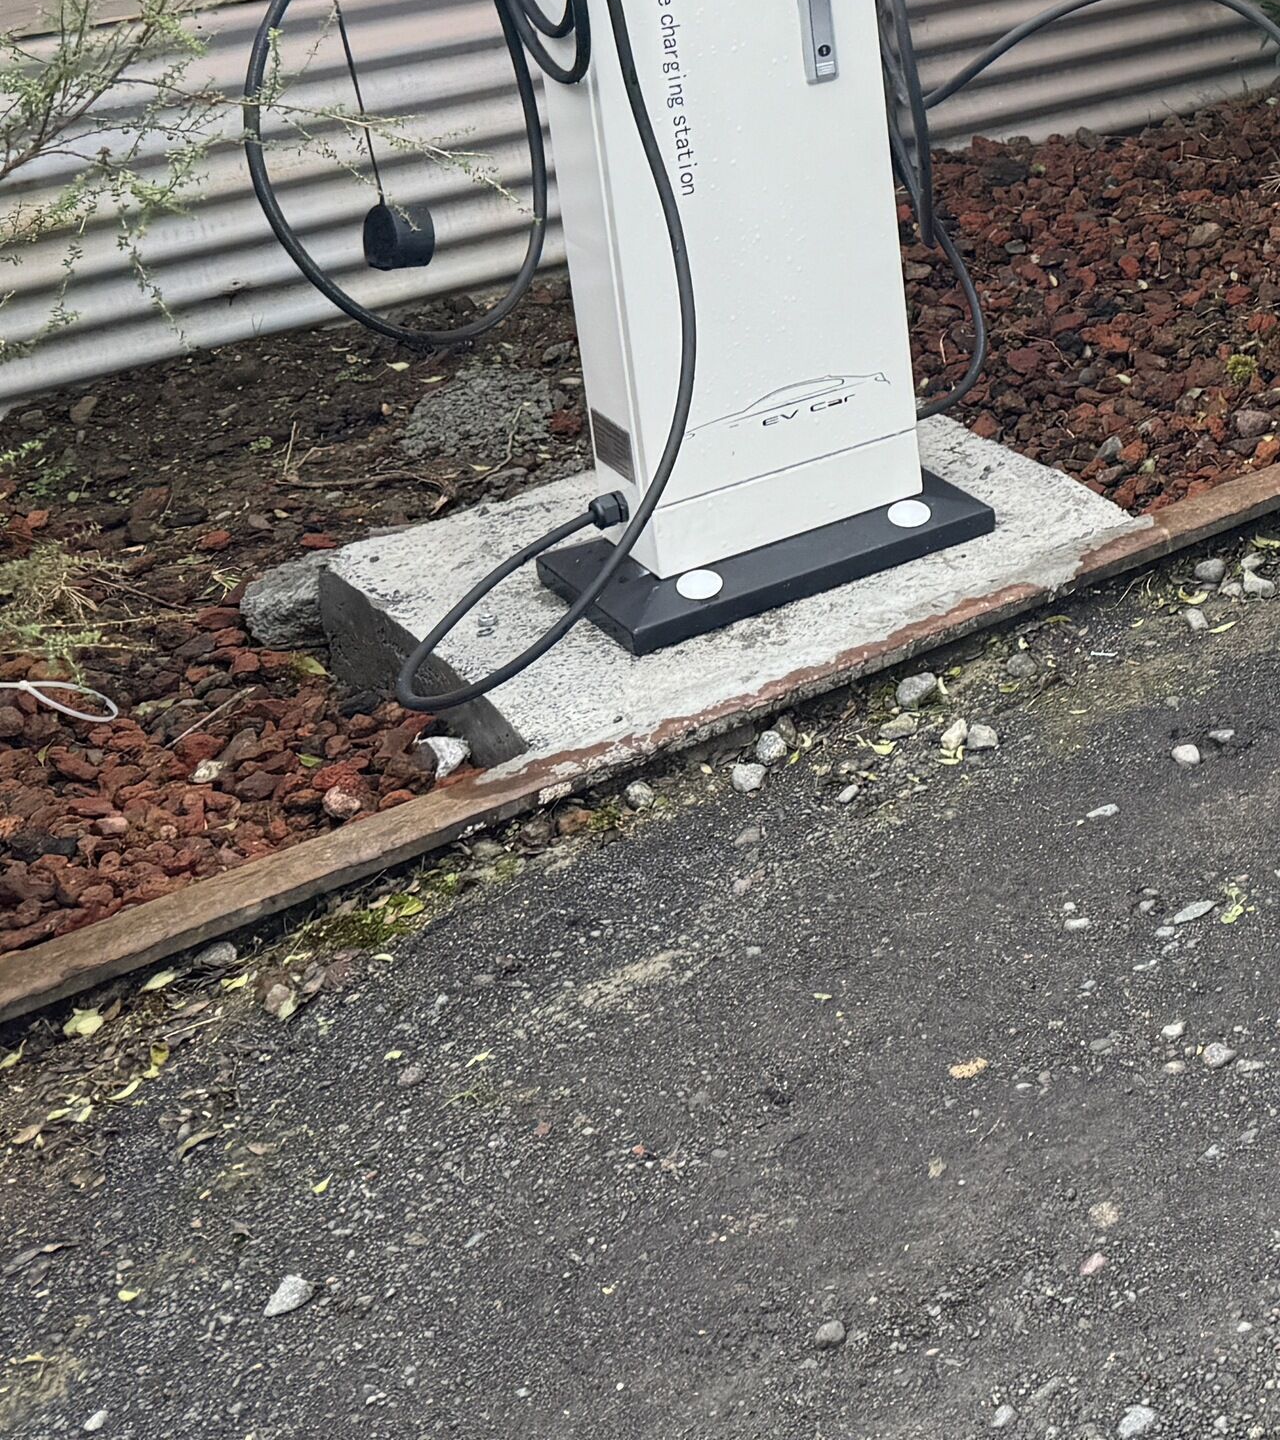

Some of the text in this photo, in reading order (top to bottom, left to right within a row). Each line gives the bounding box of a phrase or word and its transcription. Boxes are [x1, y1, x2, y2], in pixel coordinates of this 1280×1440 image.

[660, 13, 687, 109] charging
[673, 114, 698, 197] station
[762, 409, 799, 427] EV
